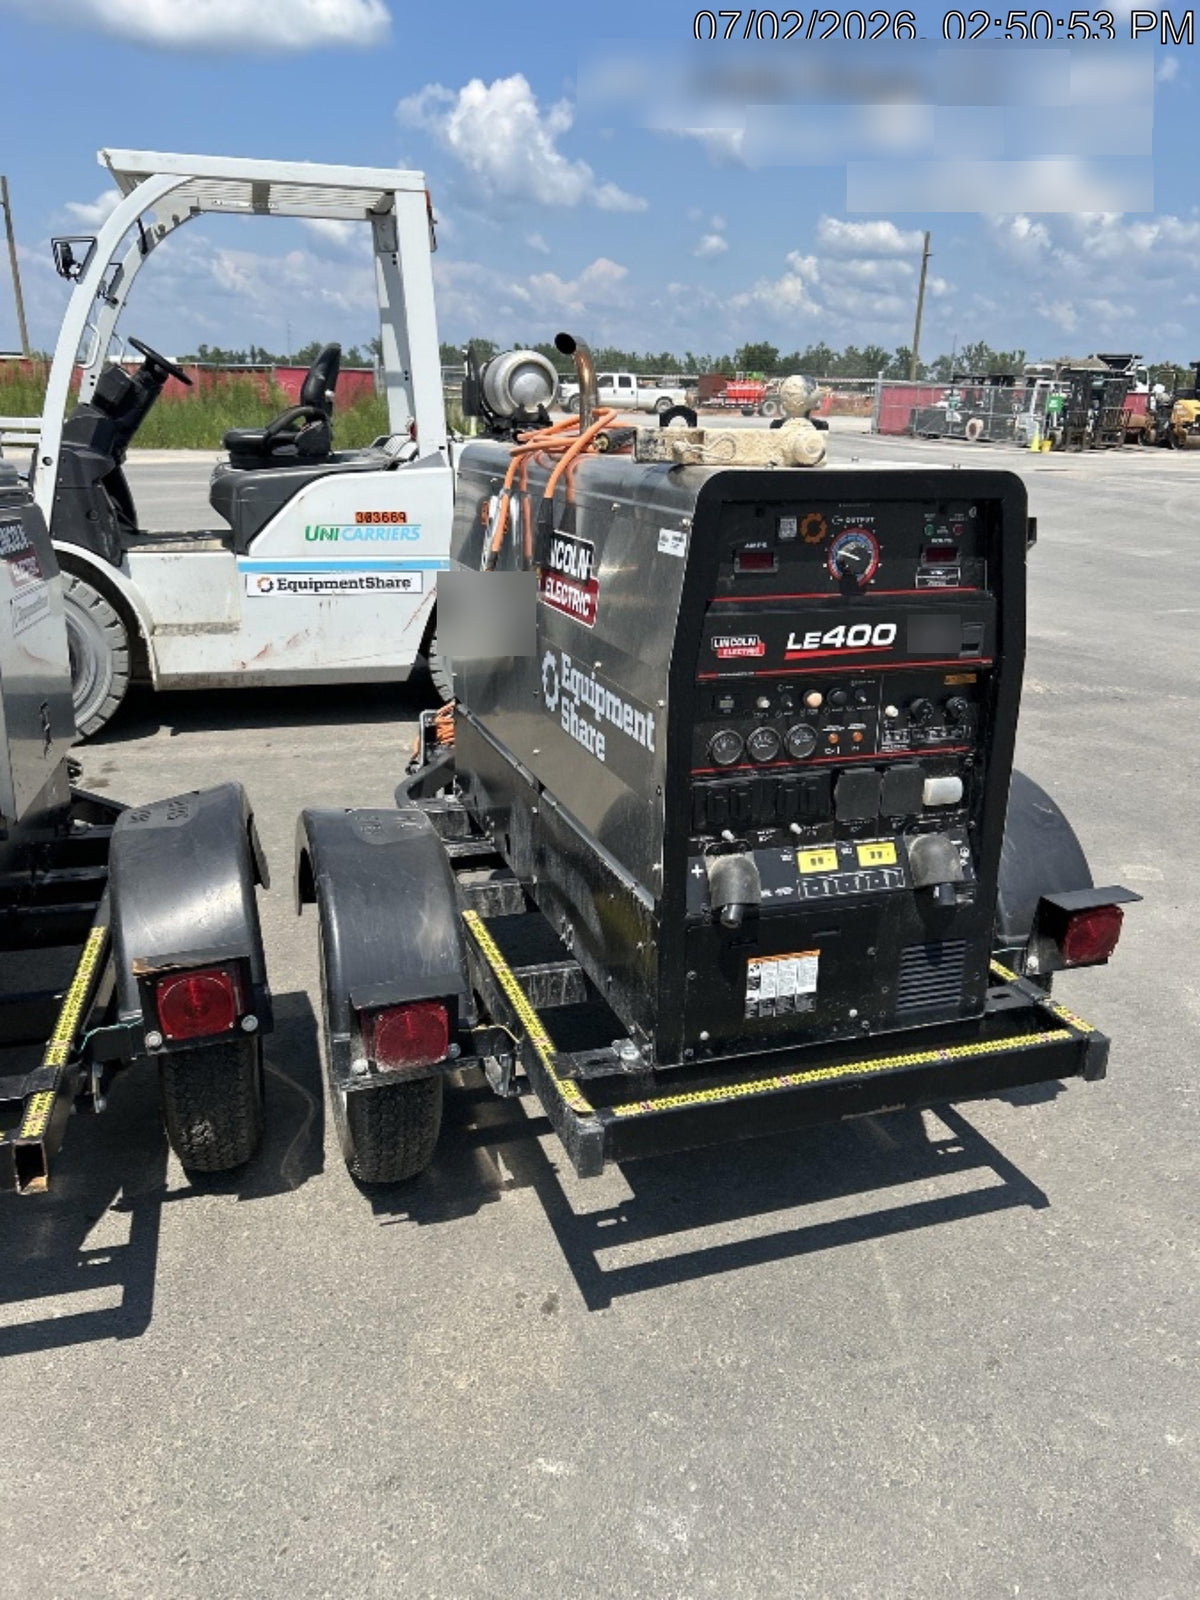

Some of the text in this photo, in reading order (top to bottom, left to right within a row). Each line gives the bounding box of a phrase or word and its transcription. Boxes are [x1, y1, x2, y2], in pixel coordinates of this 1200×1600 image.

[276, 576, 412, 593] EquipmentShare
[545, 576, 591, 616] ELECTRIC
[713, 637, 757, 648] LINCOLN
[786, 623, 898, 650] LE400
[561, 652, 656, 753] Equipment
[560, 695, 606, 761] Share
